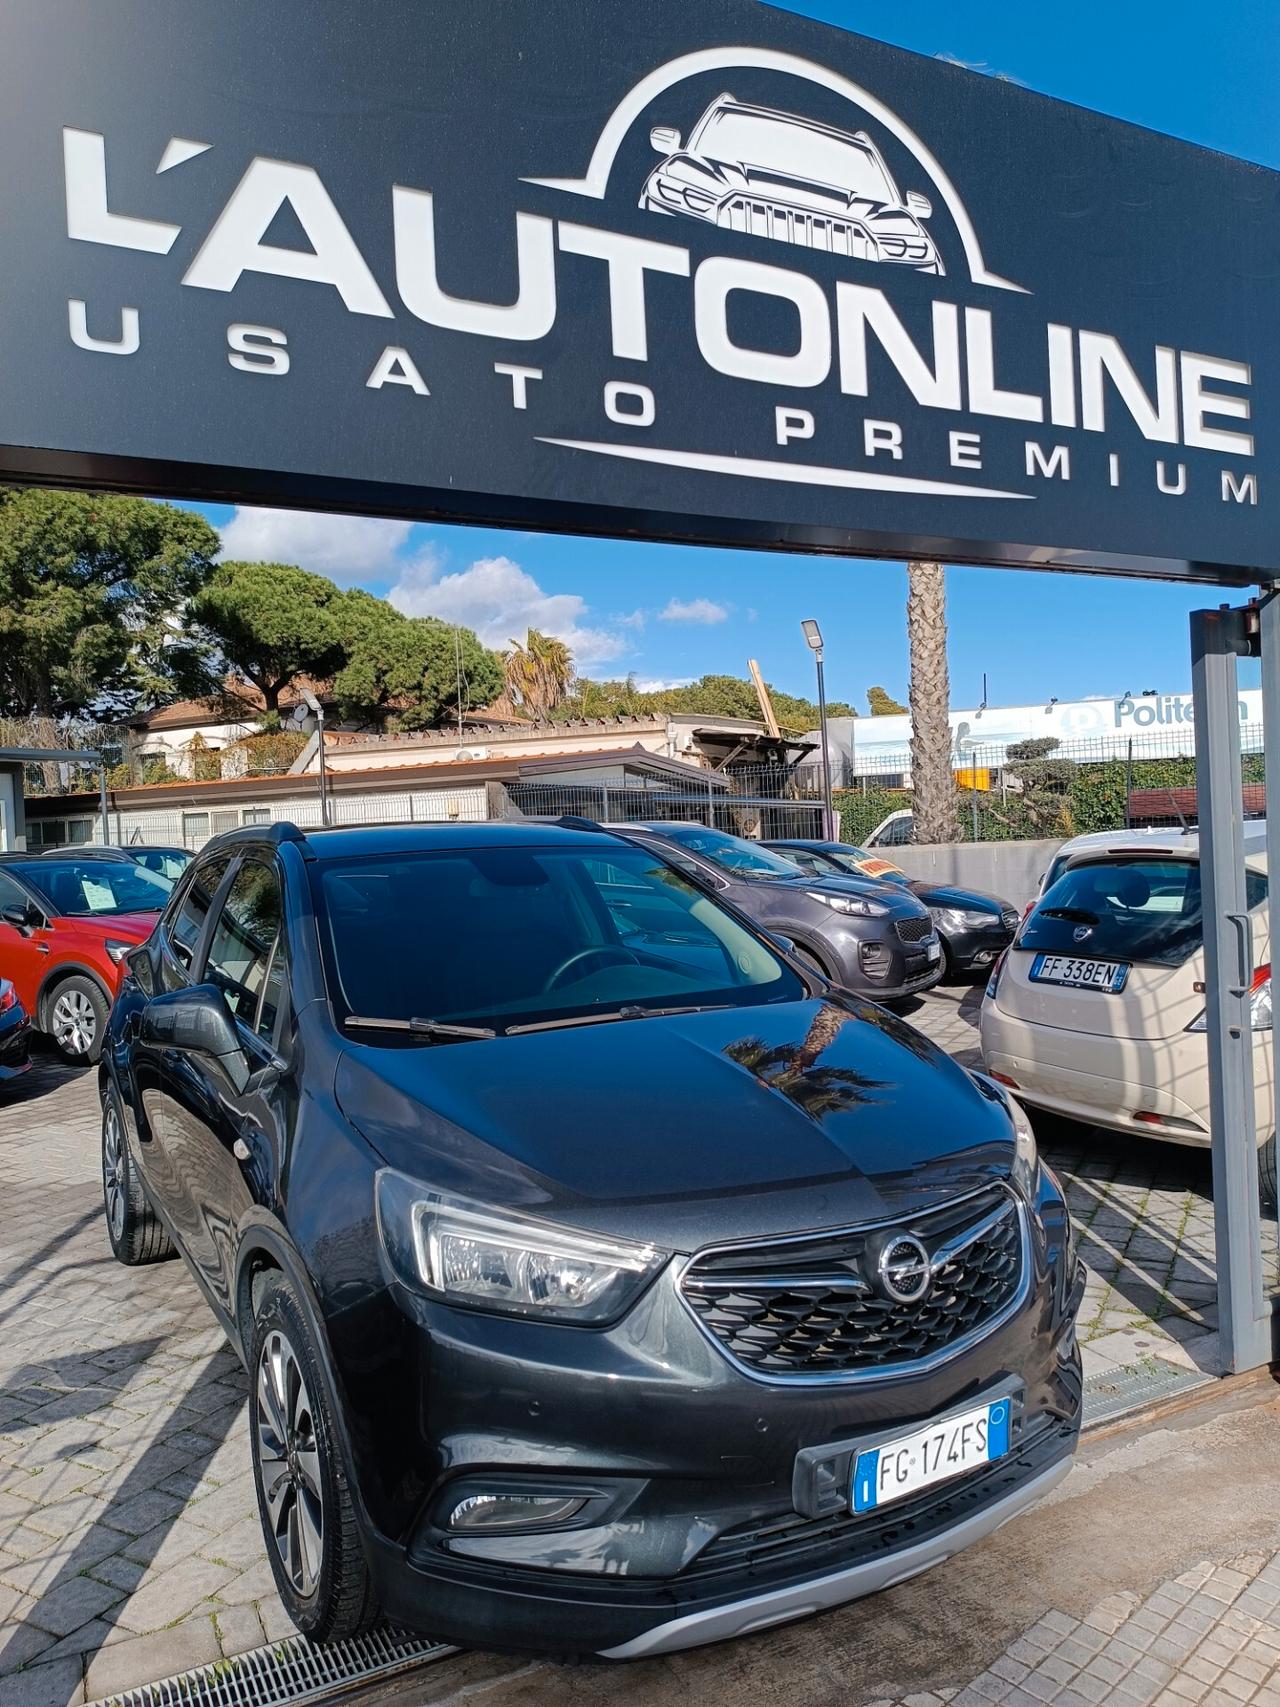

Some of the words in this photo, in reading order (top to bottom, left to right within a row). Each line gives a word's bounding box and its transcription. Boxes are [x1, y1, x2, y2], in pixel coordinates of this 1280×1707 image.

[62, 126, 1256, 456] L'AUTONLINE
[68, 298, 656, 427] USATO
[775, 406, 1259, 506] PREMIUM
